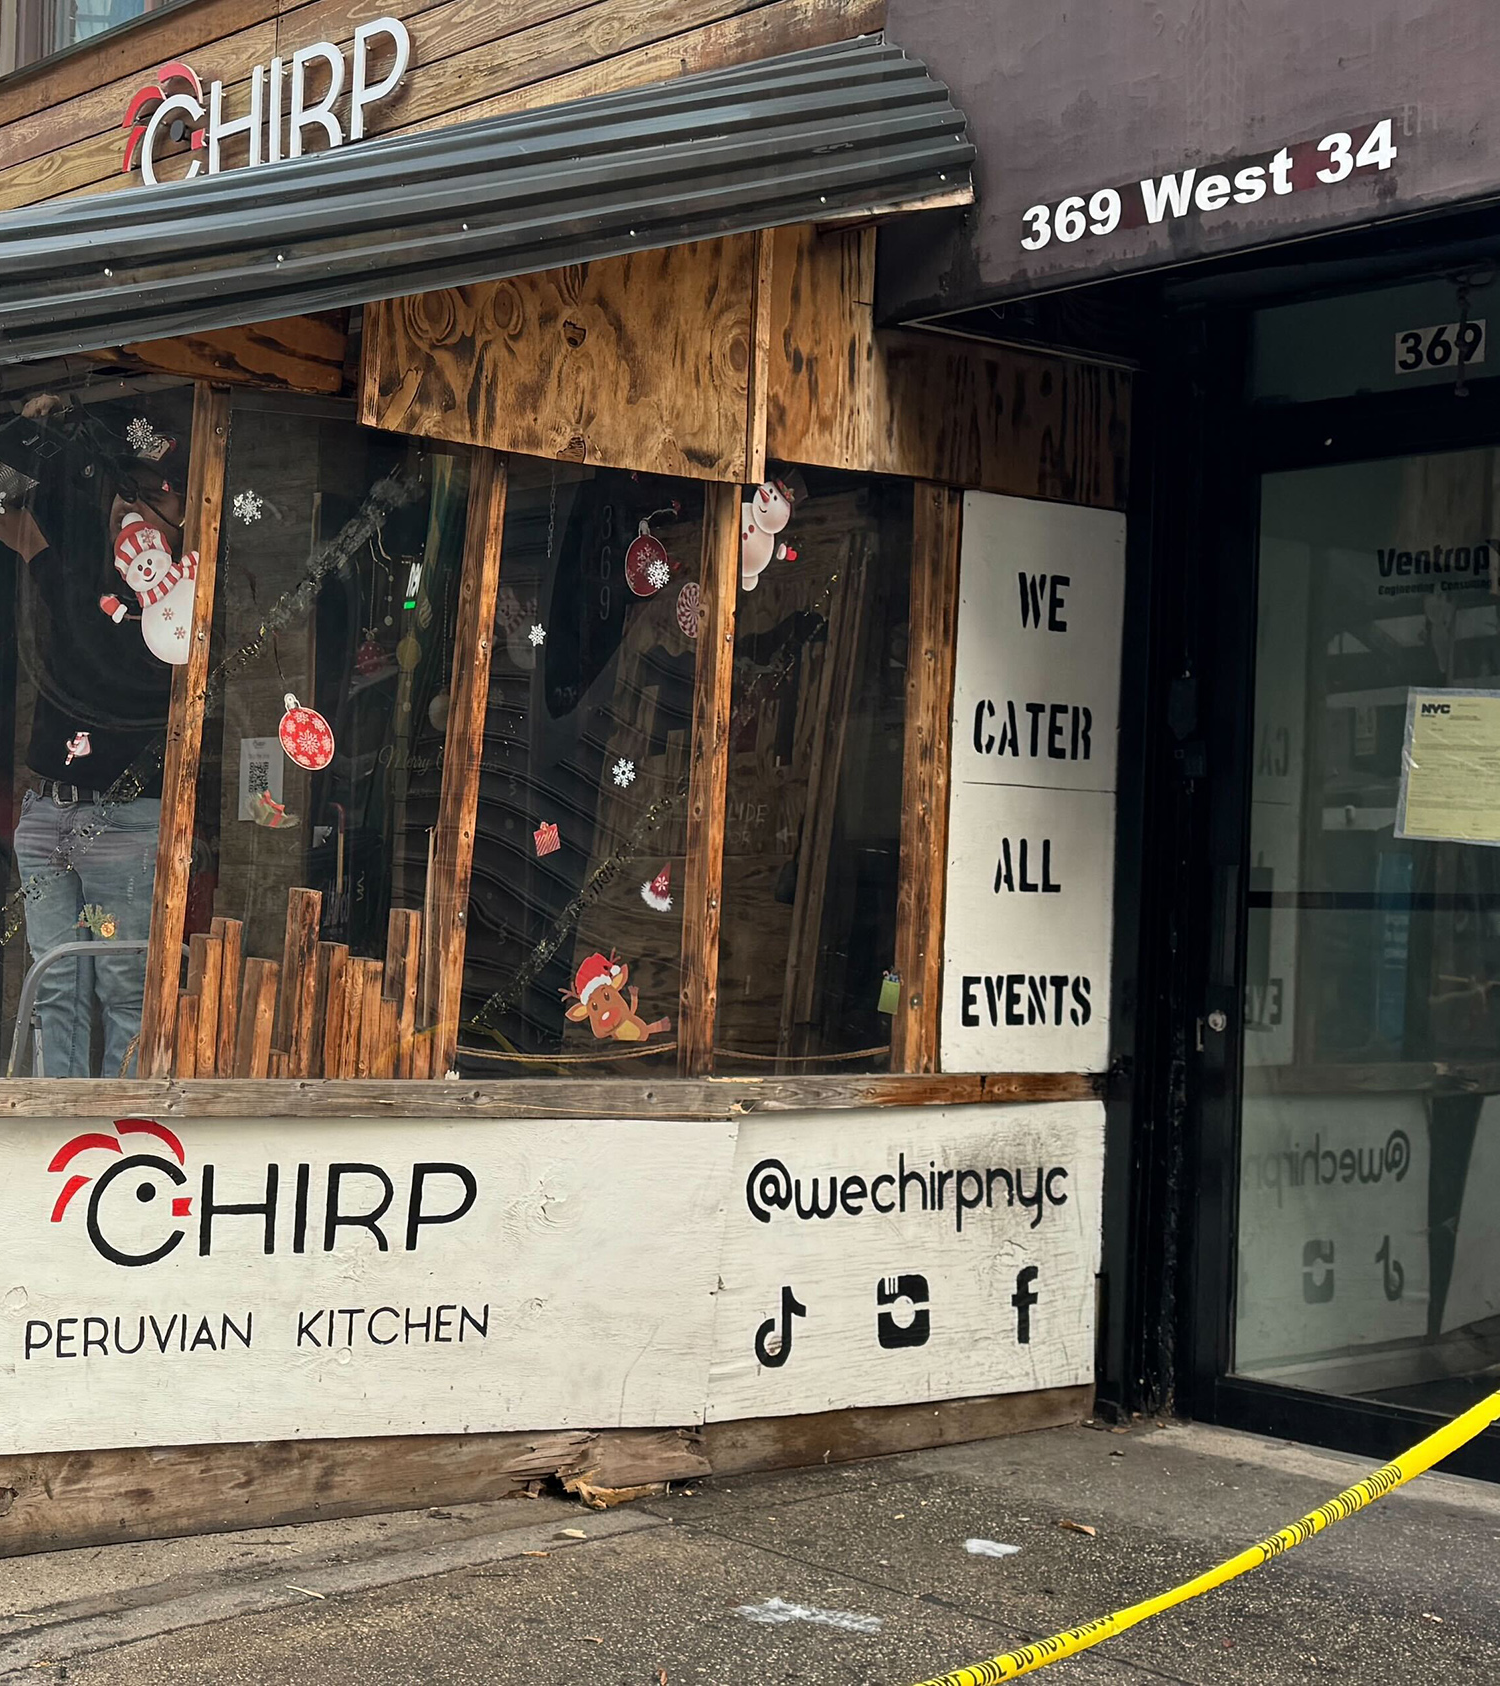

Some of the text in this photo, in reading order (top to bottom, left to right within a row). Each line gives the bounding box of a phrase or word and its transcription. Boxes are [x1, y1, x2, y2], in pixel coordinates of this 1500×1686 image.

[141, 16, 410, 186] CHIRP
[1020, 188, 1123, 250] 369
[1140, 147, 1294, 224] West
[1315, 118, 1398, 184] 34
[1398, 322, 1484, 371] 369
[1376, 544, 1491, 577] Ventrop
[1017, 570, 1071, 633] WE
[973, 698, 1093, 761] CATER
[1421, 703, 1451, 714] NYC
[726, 803, 768, 823] LIDE
[994, 837, 1062, 894] ALL
[961, 973, 1092, 1028] EVENTS
[86, 1153, 478, 1268] CHIRP
[746, 1152, 1069, 1232] @wechirpnyc
[25, 1303, 490, 1361] PERUVIAN KITCHEN
